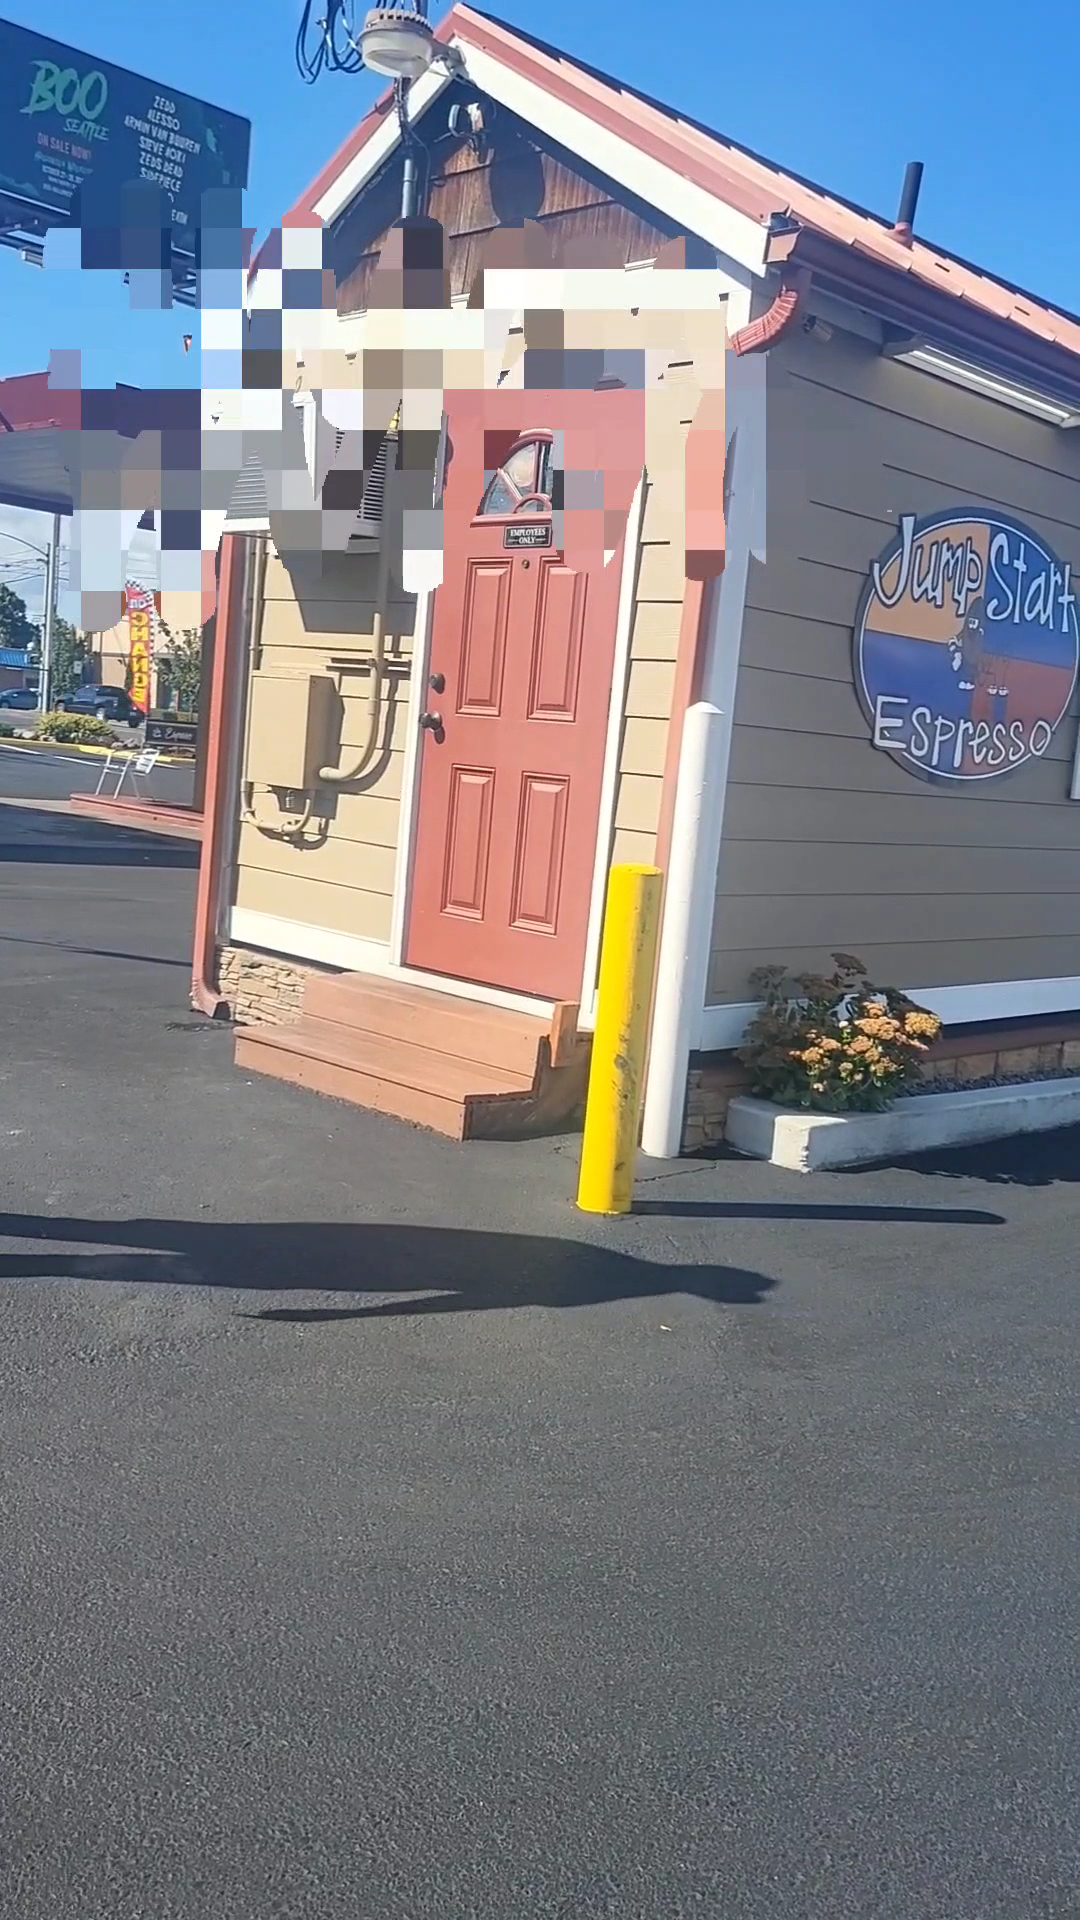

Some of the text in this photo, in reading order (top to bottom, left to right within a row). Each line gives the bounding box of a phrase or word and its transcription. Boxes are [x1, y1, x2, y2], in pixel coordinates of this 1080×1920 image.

[19, 60, 109, 120] BOO
[153, 95, 176, 114] ZEDD
[63, 118, 110, 142] SEATTLE
[147, 109, 181, 131] ALESSO
[37, 132, 49, 147] ON
[50, 137, 70, 154] SALE
[124, 115, 202, 155] ARMIN VAN BUUREN
[138, 135, 186, 164] STEVE AOKI
[139, 151, 184, 178] ZEDS DEAD
[510, 528, 546, 537] EMPLOYEES
[518, 536, 536, 544] ONLY
[873, 515, 1076, 633] Jump Start
[873, 695, 1051, 769] Espresso
